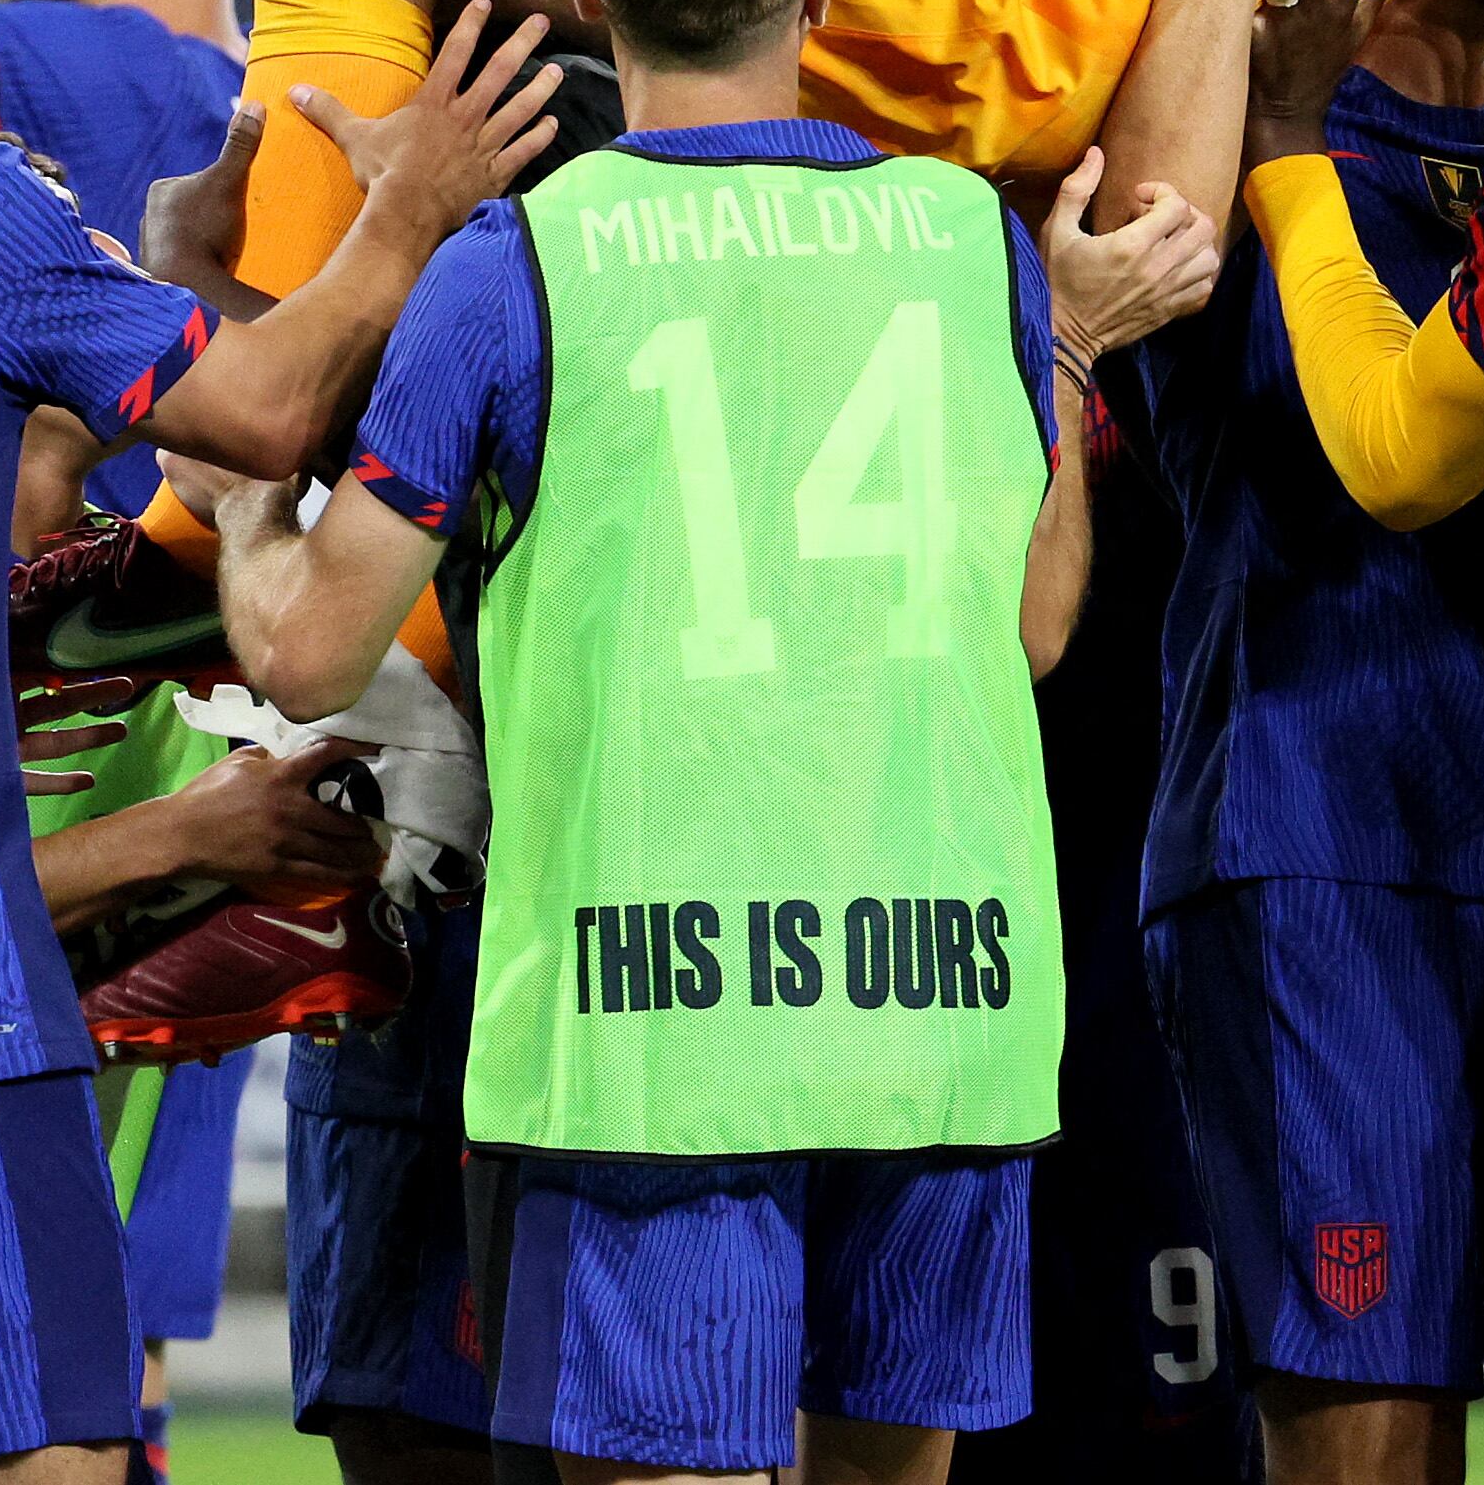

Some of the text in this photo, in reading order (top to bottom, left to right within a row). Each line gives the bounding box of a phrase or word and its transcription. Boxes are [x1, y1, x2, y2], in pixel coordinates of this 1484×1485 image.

[579, 184, 955, 274] MIHAILOVIC
[626, 300, 959, 681] 14
[574, 897, 1011, 1014] THIS IS OURS
[1322, 1229, 1382, 1264] USA
[1150, 1247, 1218, 1384] 9
